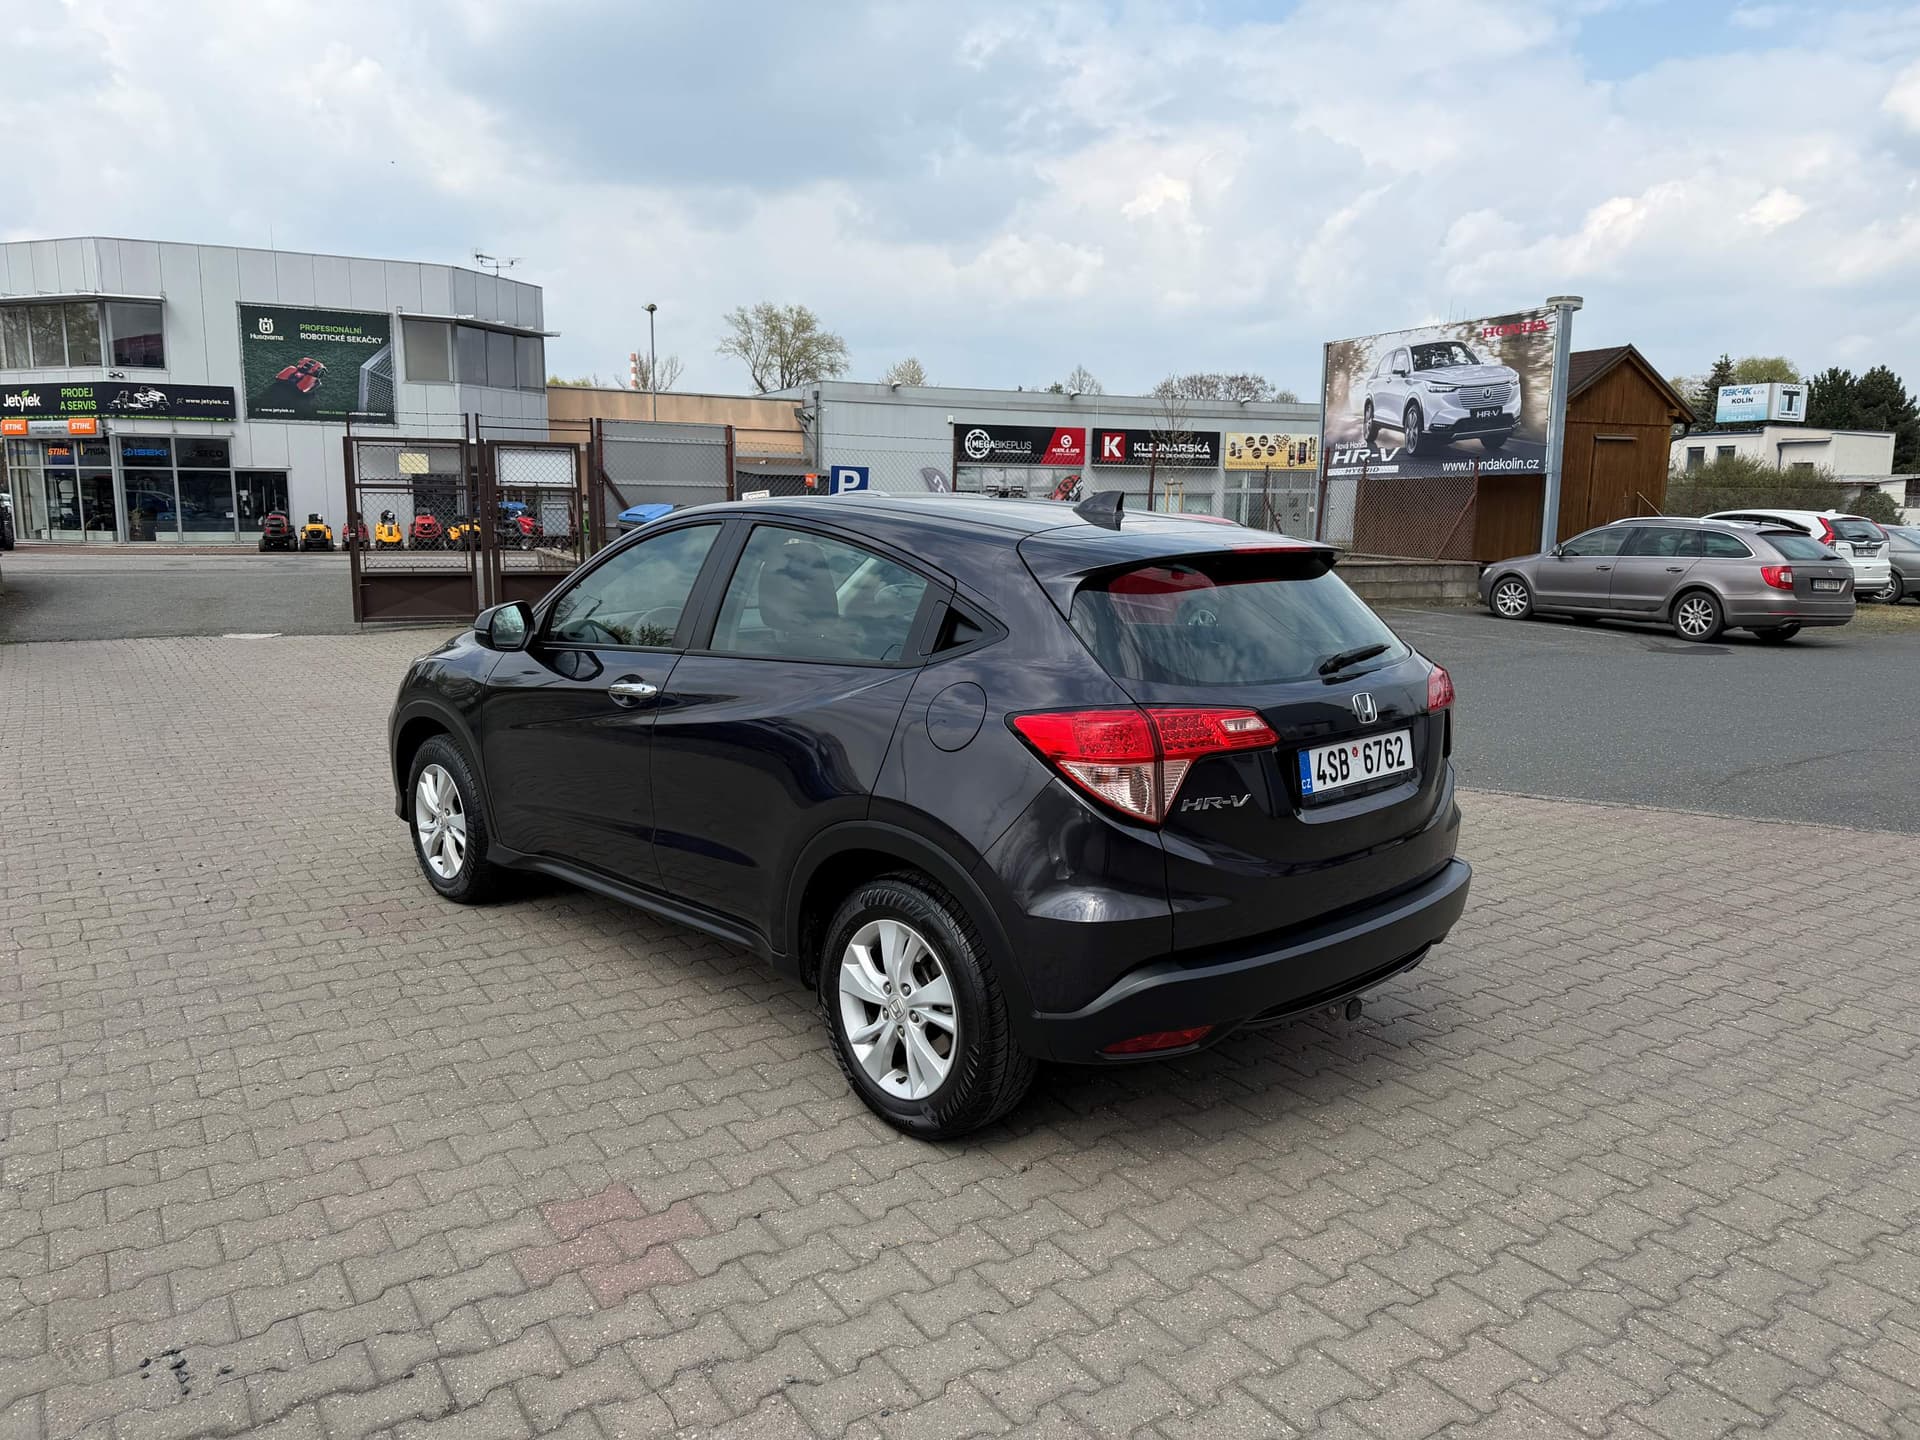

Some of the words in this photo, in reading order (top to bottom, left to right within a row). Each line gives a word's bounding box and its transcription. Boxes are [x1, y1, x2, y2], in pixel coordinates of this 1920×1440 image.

[299, 323, 362, 334] PROFESIONÁLNÍ
[1482, 320, 1548, 339] HONDA
[249, 333, 284, 341] Husqvarna
[300, 332, 345, 342] ROBOTICKÉ
[347, 335, 383, 345] SEKAČKY
[61, 387, 94, 398] PRODEJ
[60, 401, 67, 411] A
[69, 400, 97, 411] SERVIS
[1731, 397, 1754, 405] KOLÍN
[1782, 390, 1801, 411] T
[71, 422, 92, 430] STIHL
[47, 447, 70, 456] STIHL
[134, 448, 167, 456] ISEKI
[1104, 436, 1122, 457] K
[1331, 447, 1401, 465] HR-V
[838, 469, 861, 494] P
[1317, 748, 1350, 785] 4SB
[1363, 736, 1405, 774] 6762
[1301, 778, 1312, 790] CZ
[1181, 794, 1251, 812] HR-V
